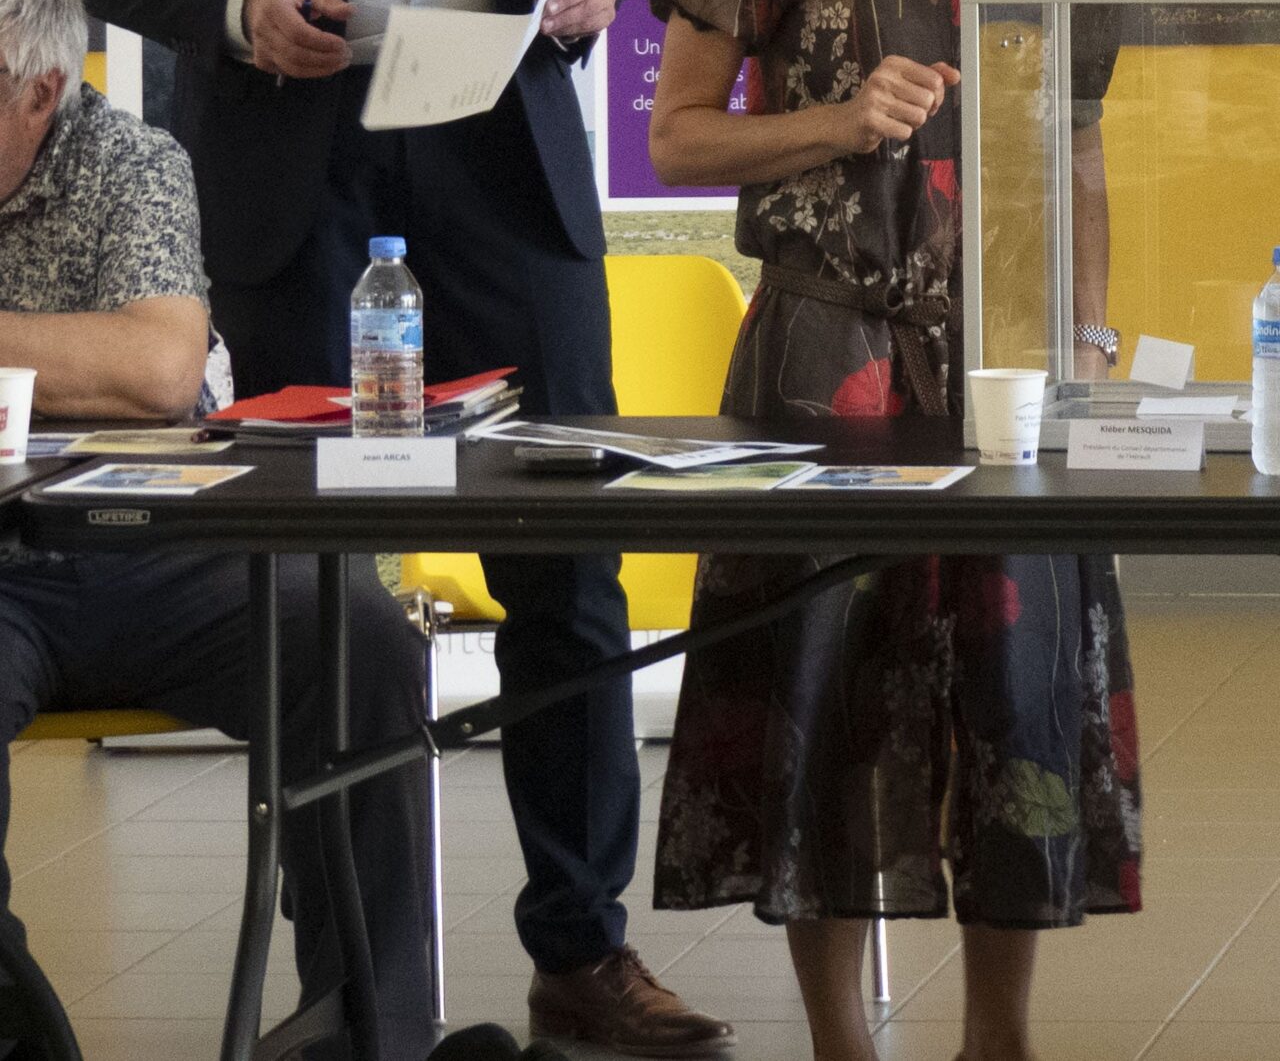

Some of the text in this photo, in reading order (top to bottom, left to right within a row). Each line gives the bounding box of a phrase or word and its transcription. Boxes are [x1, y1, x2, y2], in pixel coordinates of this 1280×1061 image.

[634, 38, 661, 55] Un
[1099, 424, 1172, 436] Kléber MESQUIDA
[362, 452, 411, 462] Jean ARCAS
